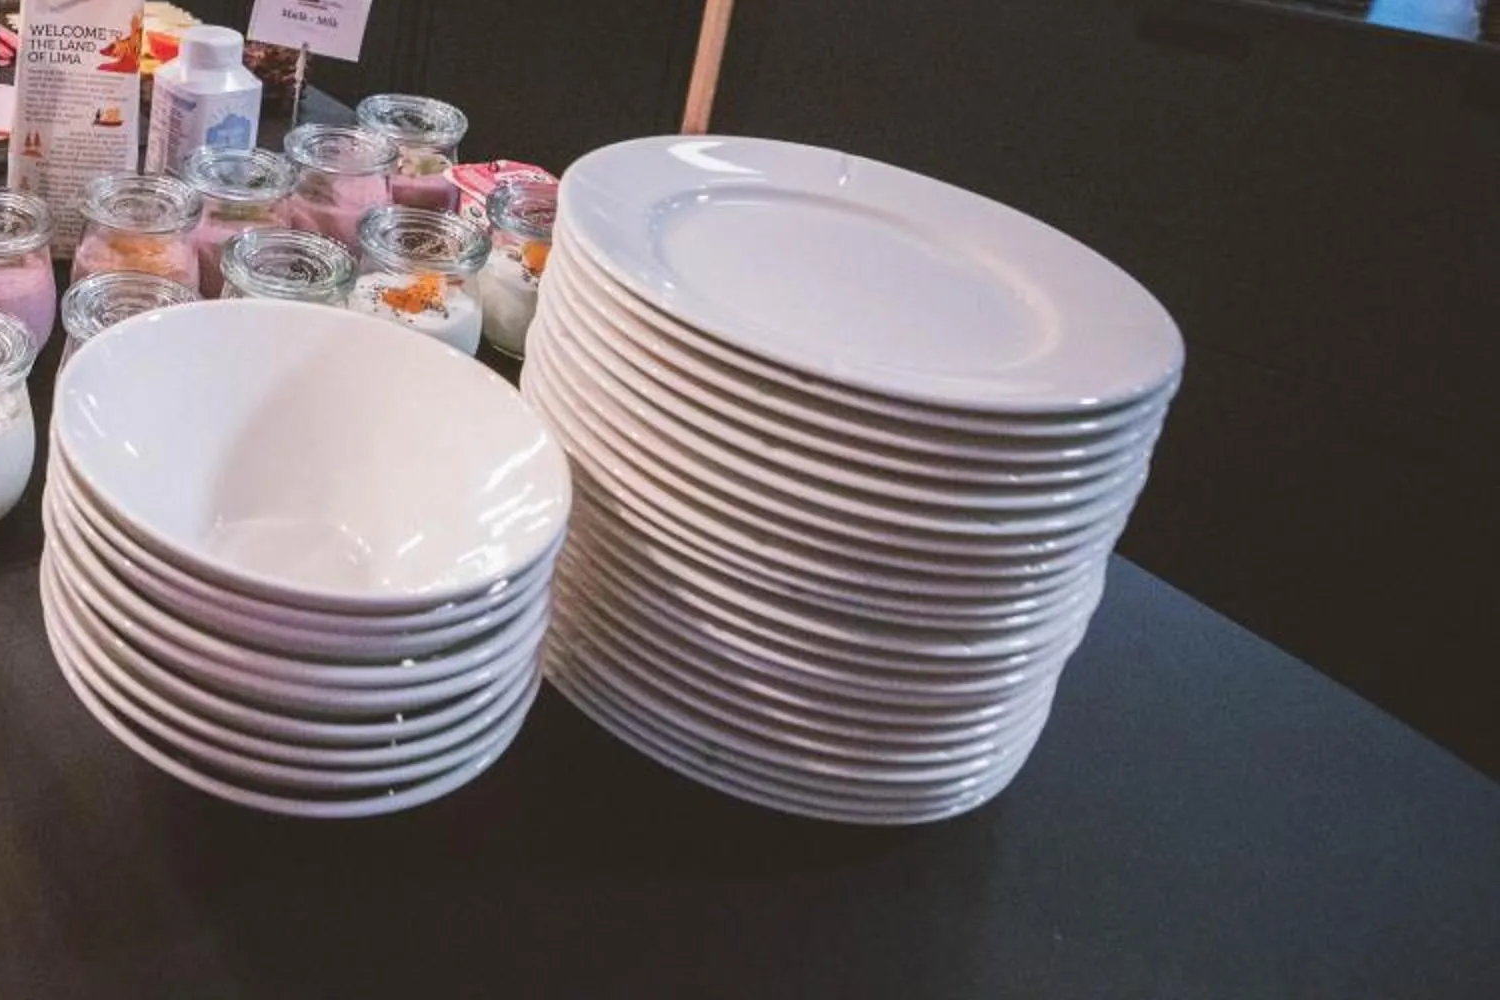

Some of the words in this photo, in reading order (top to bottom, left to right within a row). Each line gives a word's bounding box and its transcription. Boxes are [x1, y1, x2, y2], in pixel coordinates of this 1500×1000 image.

[30, 24, 107, 40] WELCOME
[30, 39, 55, 50] THE
[59, 40, 97, 52] LAND
[28, 52, 46, 63] OF
[49, 52, 82, 64] LIMA
